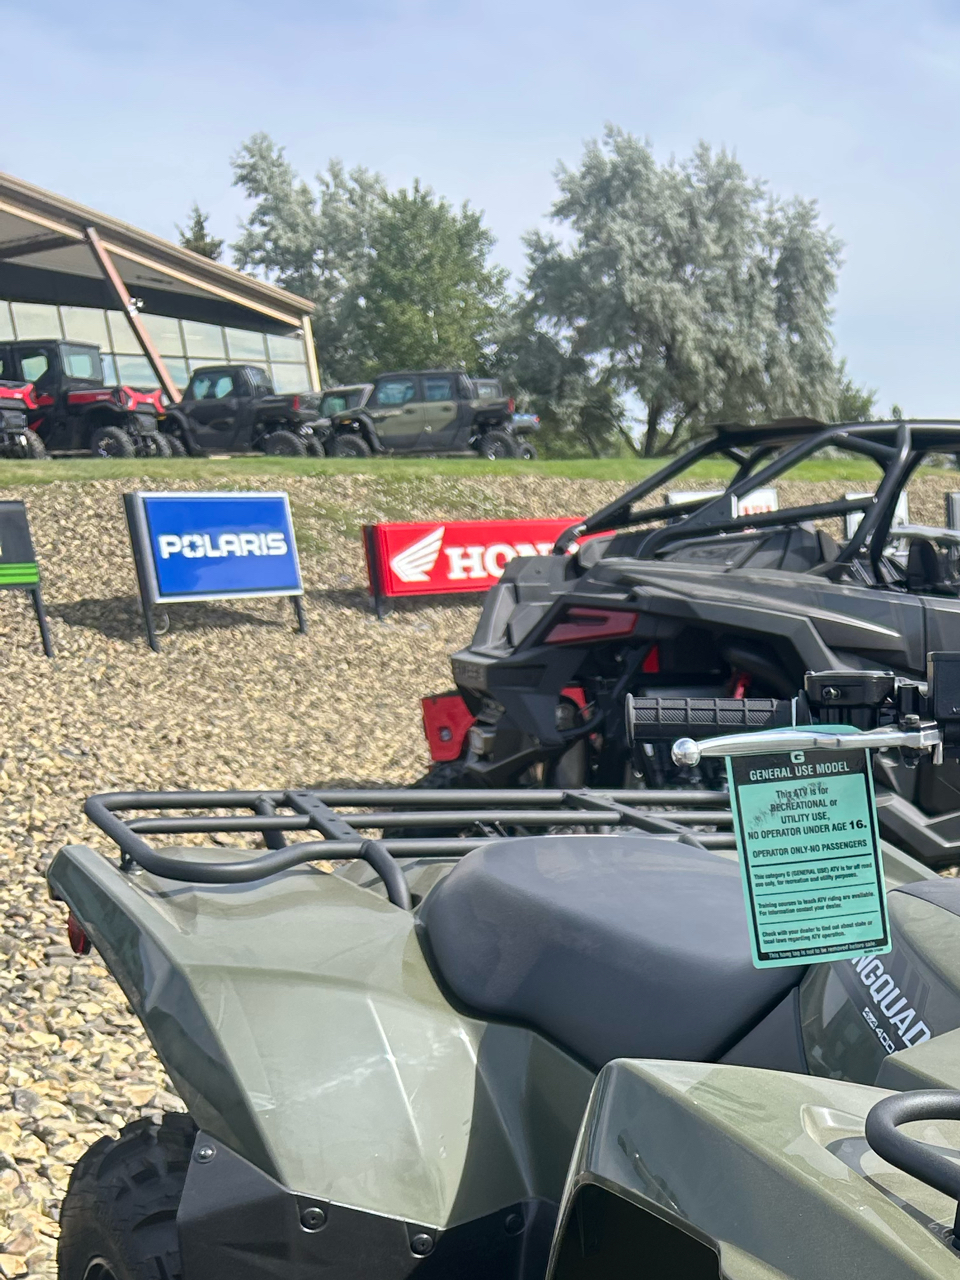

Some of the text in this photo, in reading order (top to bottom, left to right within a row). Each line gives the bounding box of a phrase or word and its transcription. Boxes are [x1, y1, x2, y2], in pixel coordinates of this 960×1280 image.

[158, 532, 288, 560] POLARIS
[790, 751, 805, 763] G
[749, 761, 850, 780] GENERAL USE MODEL
[776, 786, 828, 799] This ATV is for
[770, 799, 828, 812] RECREATIONAL
[781, 811, 830, 824] UTILITY USE,
[748, 819, 867, 840] NO OPERATOR UNDER AGE 16.
[753, 839, 867, 858] OPERATOR ONLY-NO PASSENGERS
[765, 872, 785, 880] category
[768, 907, 795, 915] information
[788, 935, 811, 943] regarding
[851, 955, 931, 1048] NGQUAD
[876, 1028, 895, 1054] 400
